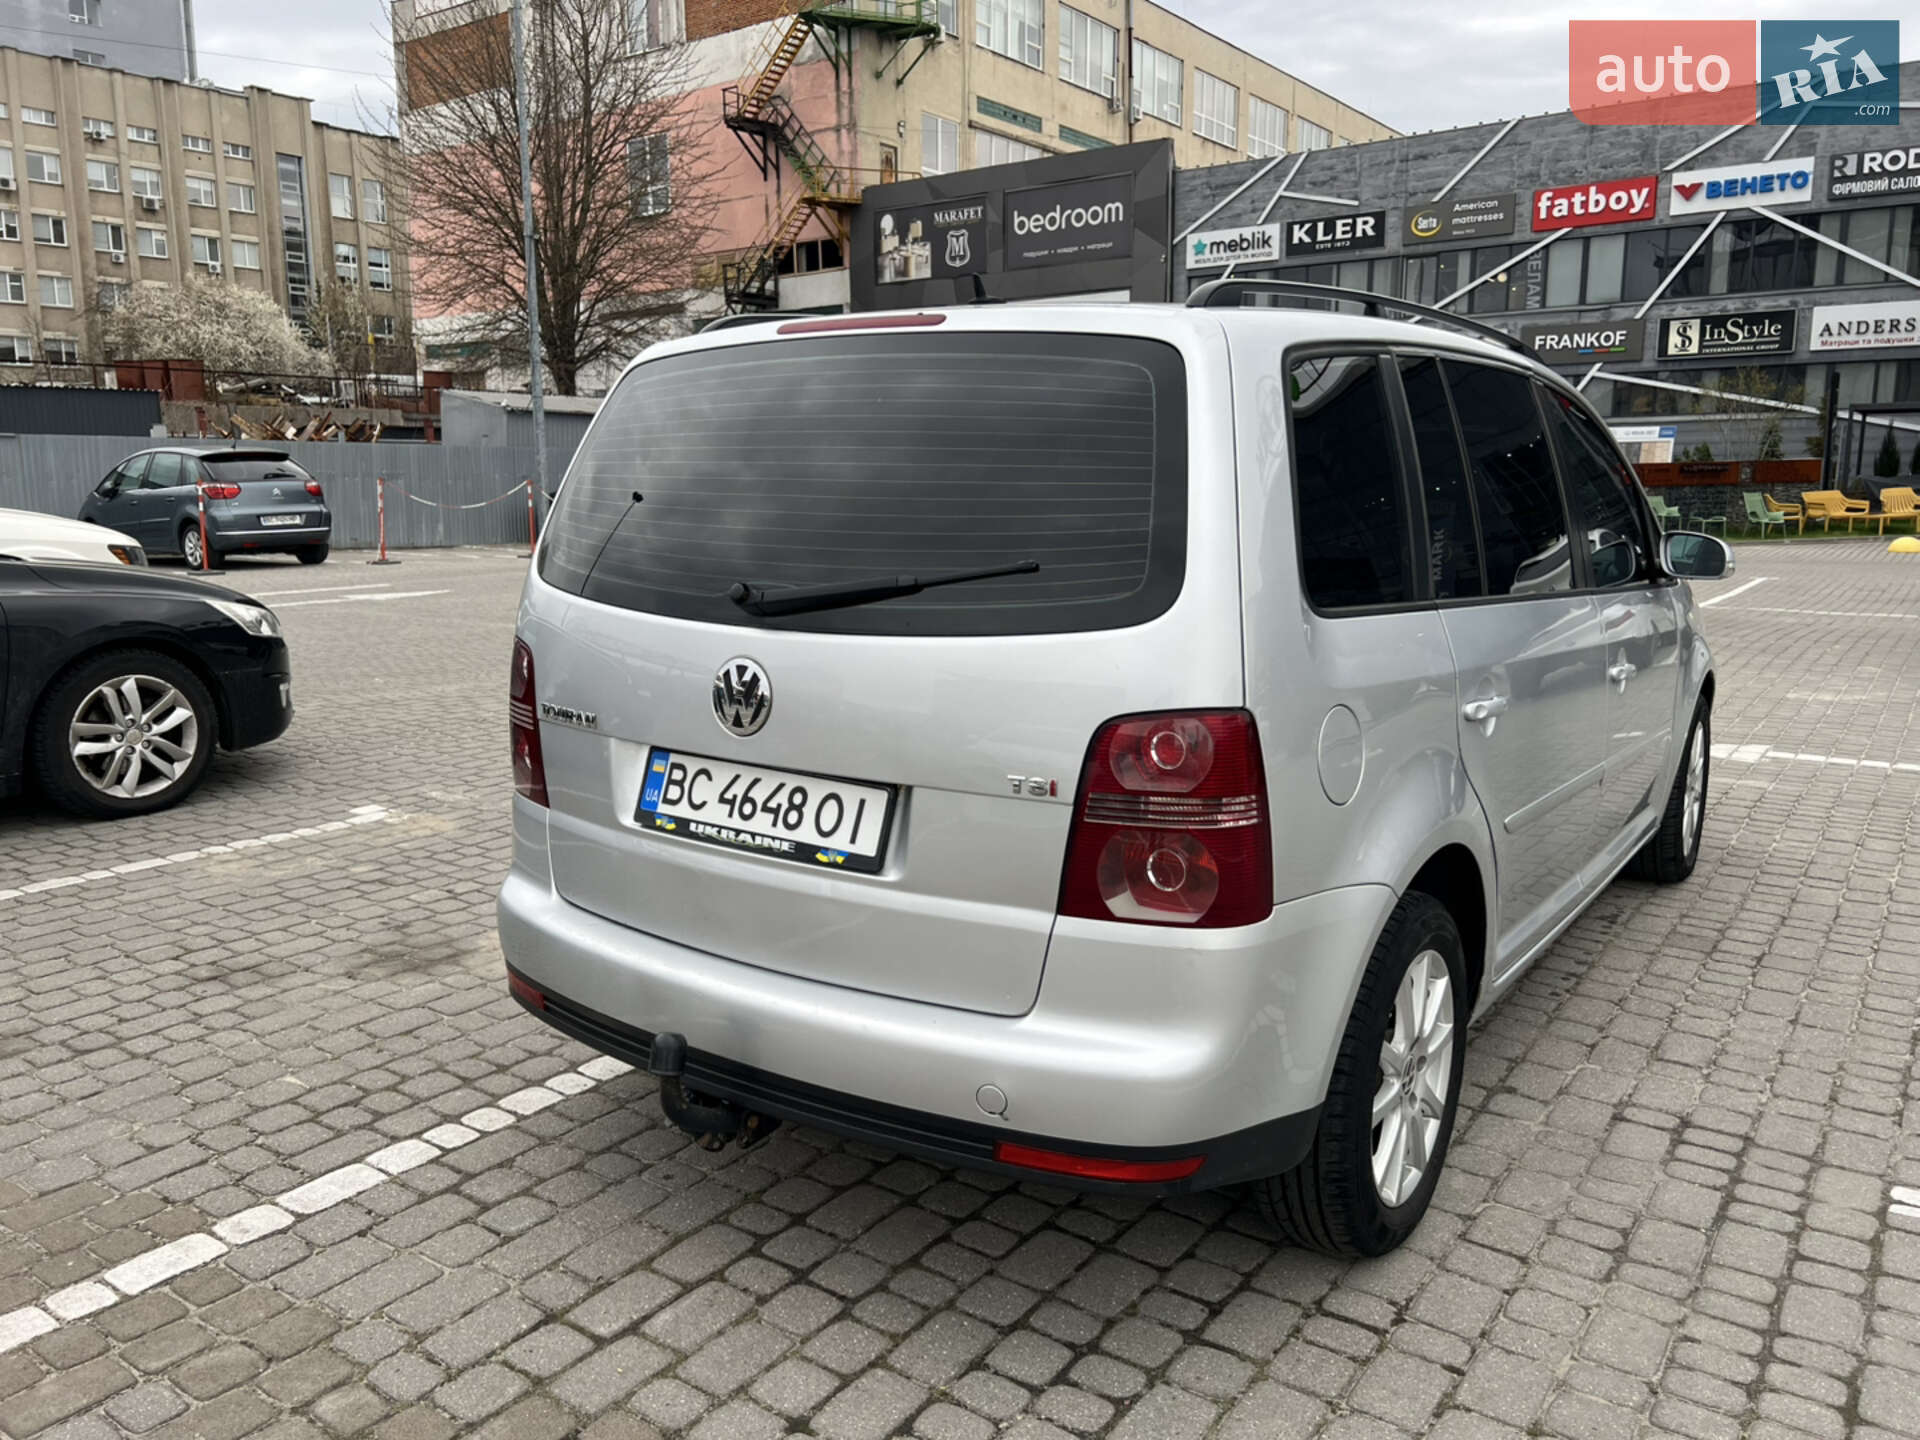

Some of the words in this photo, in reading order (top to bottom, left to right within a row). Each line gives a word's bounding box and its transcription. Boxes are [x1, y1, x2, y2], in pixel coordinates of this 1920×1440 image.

[1705, 170, 1810, 199] ВЕНЕТО
[1832, 176, 1889, 196] ФІРМОВИЙ
[933, 205, 984, 224] MARAFET
[1453, 200, 1498, 212] American
[1538, 185, 1650, 219] fatboy
[1013, 201, 1123, 235] bedroom
[1292, 216, 1376, 245] KLER
[1451, 212, 1504, 225] mattresses
[1209, 230, 1273, 256] meblik
[1534, 330, 1627, 350] FRANKOF
[1704, 317, 1782, 345] InStyle
[1819, 317, 1916, 337] ANDERS
[661, 761, 713, 811] BC
[717, 773, 809, 831] 4648
[814, 791, 867, 845] OI
[688, 821, 799, 853] UKRAINE
